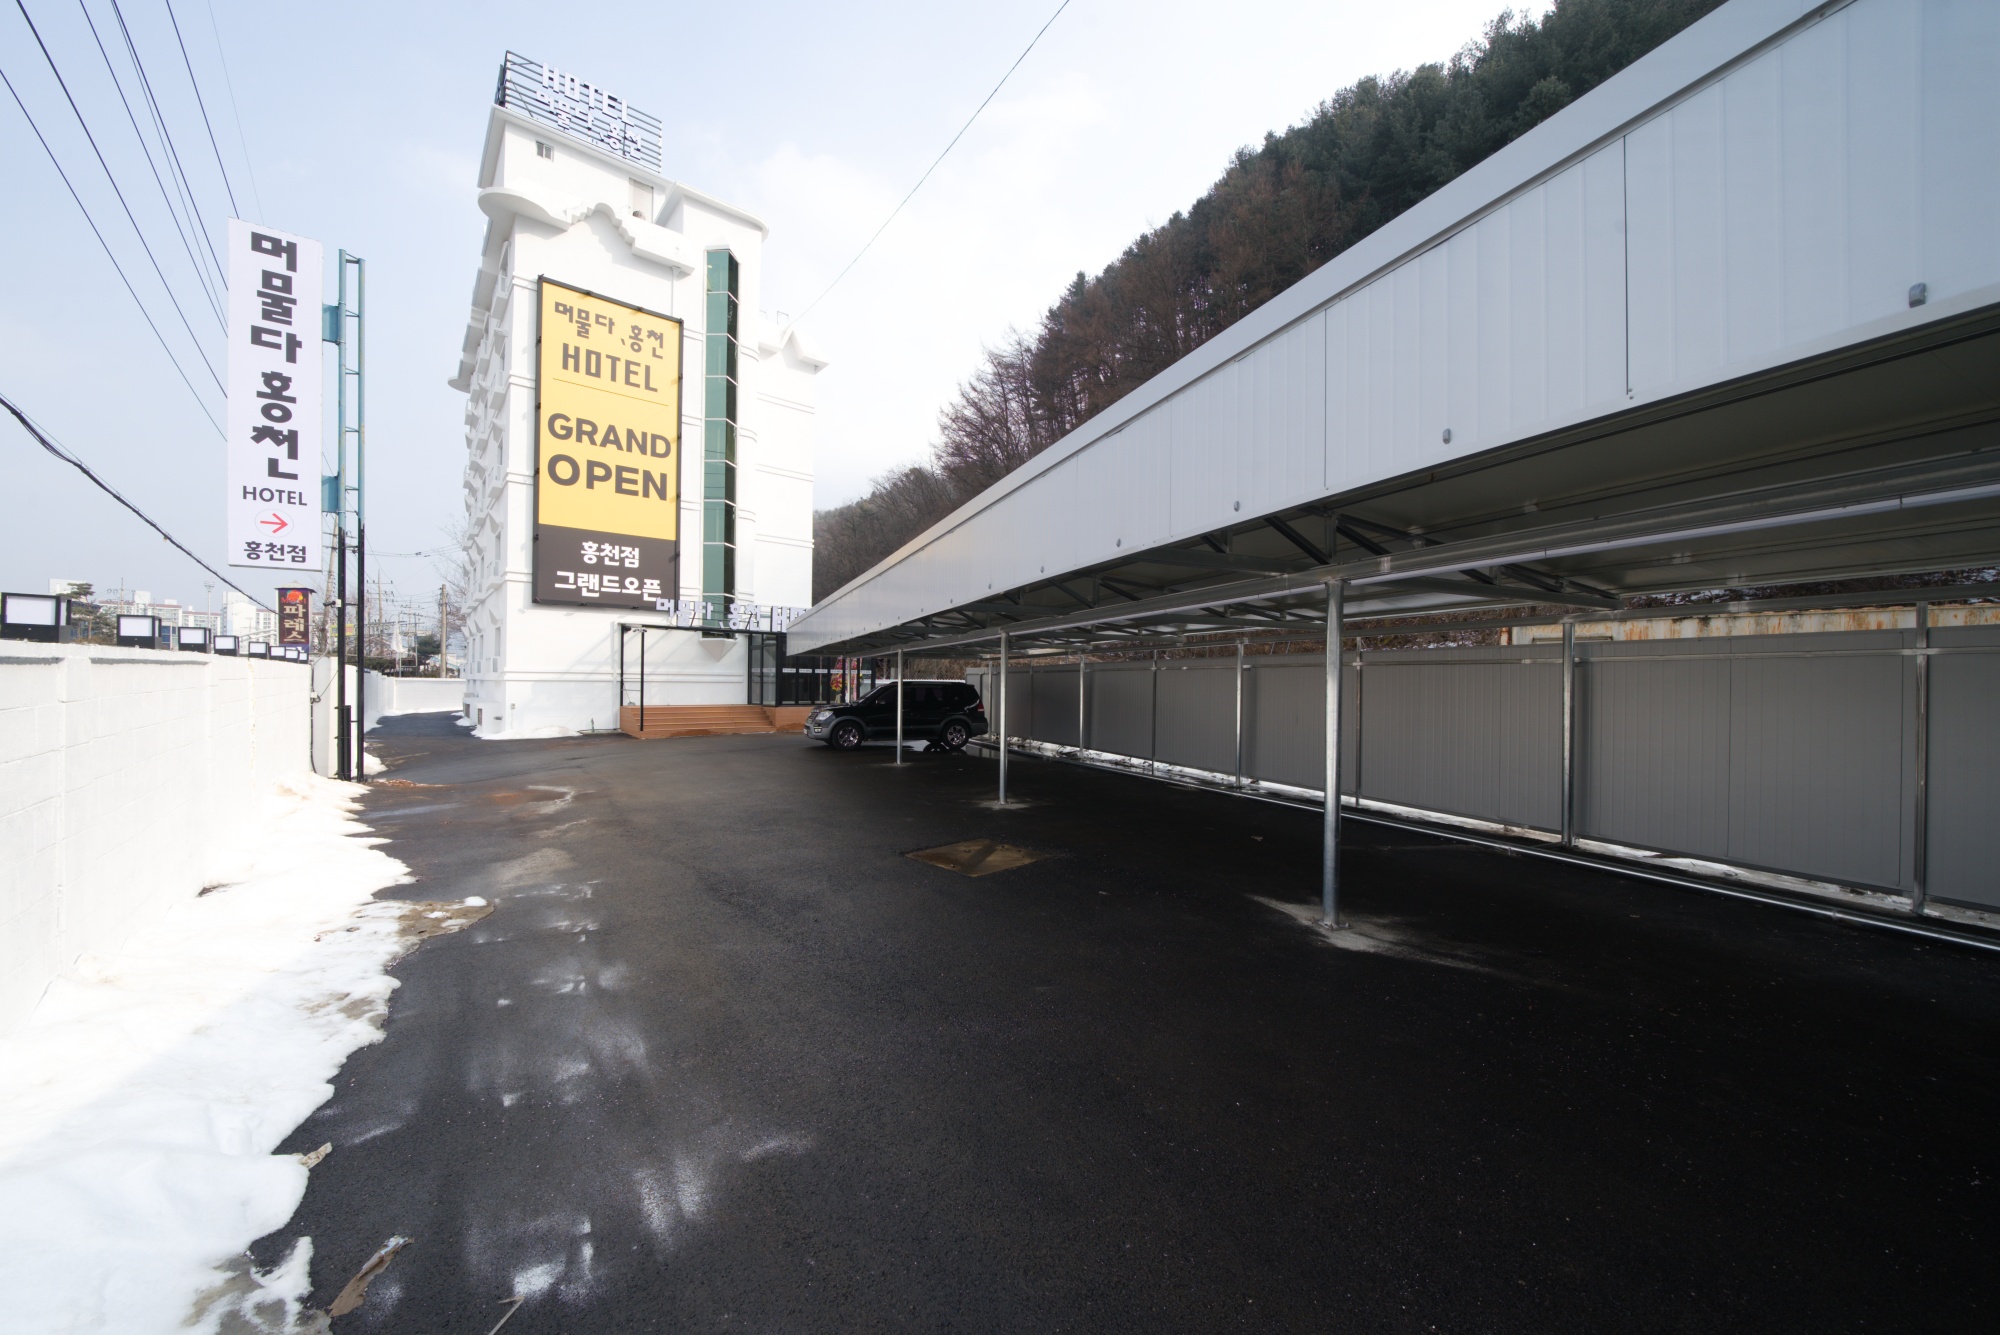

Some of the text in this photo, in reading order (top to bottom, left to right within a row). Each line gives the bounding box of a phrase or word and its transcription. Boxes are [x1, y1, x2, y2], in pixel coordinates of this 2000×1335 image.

[535, 89, 594, 131] 머물다
[542, 62, 634, 127] HOTEL
[555, 301, 615, 339] 머물다
[250, 231, 303, 480] 머물다 홍천
[562, 342, 658, 392] HOTEL
[547, 412, 672, 460] GRAND
[242, 485, 308, 507] HOTEL
[547, 453, 668, 502] OPEN
[243, 540, 307, 564] 홍천점
[580, 541, 640, 569] 홍천점
[554, 571, 662, 602] 그랜드오픈
[656, 597, 714, 628] 머물다
